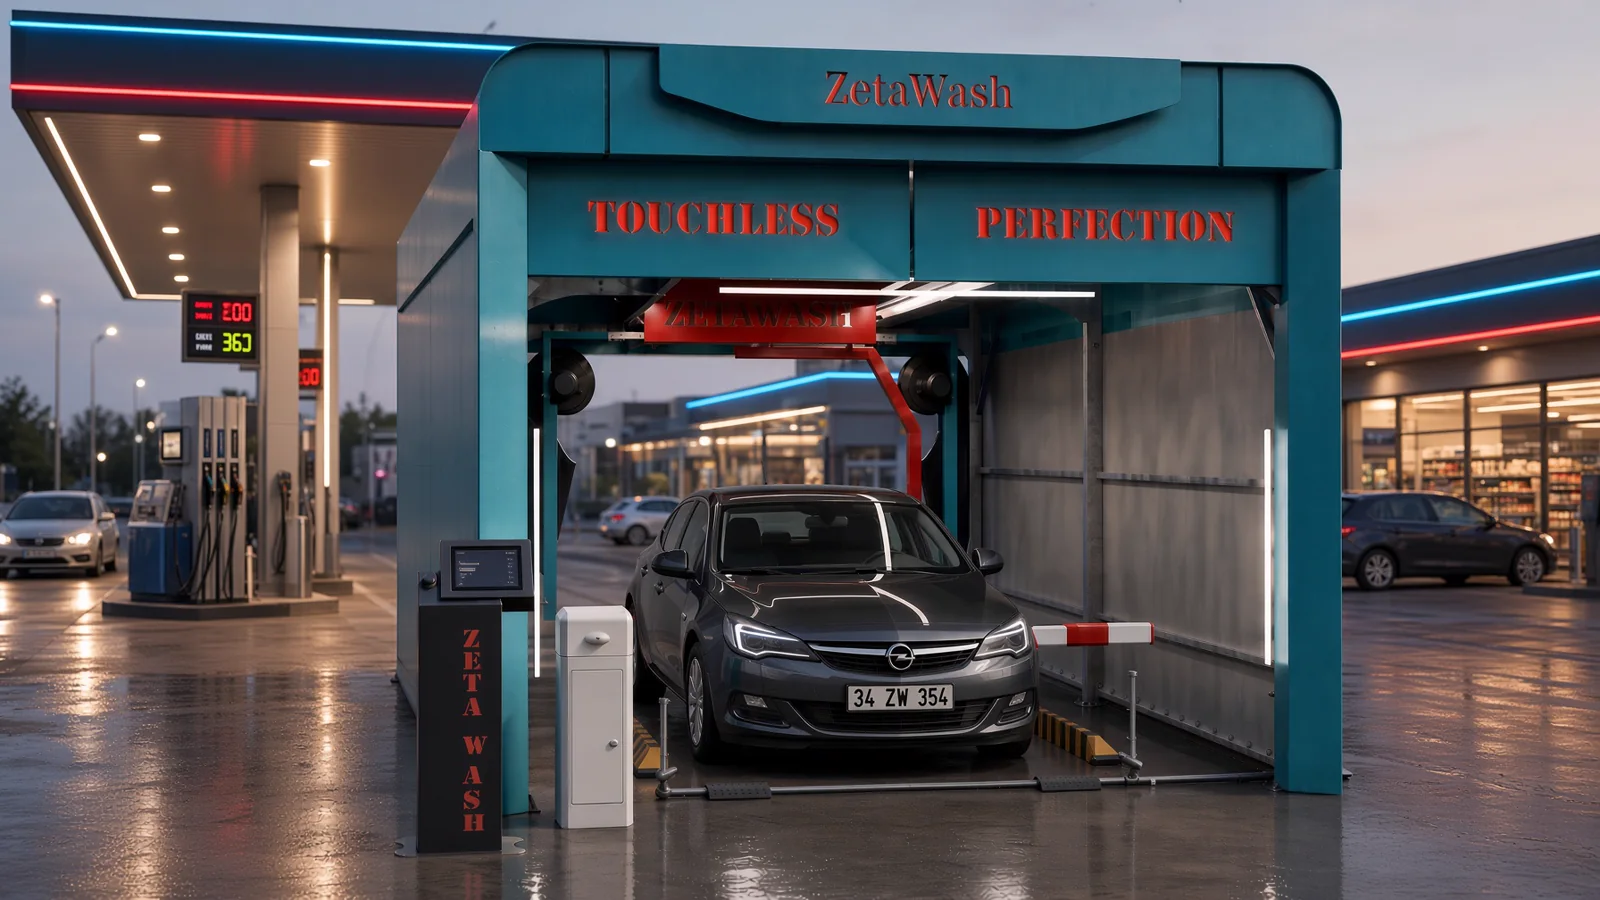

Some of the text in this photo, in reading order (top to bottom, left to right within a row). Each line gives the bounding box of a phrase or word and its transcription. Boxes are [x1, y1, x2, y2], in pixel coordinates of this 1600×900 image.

[824, 71, 1013, 108] ZetaWash
[588, 200, 1235, 242] TOUCHLESS PERFECTION
[853, 687, 949, 707] 34 ZW 354
[462, 629, 488, 832] ZETA WASH
